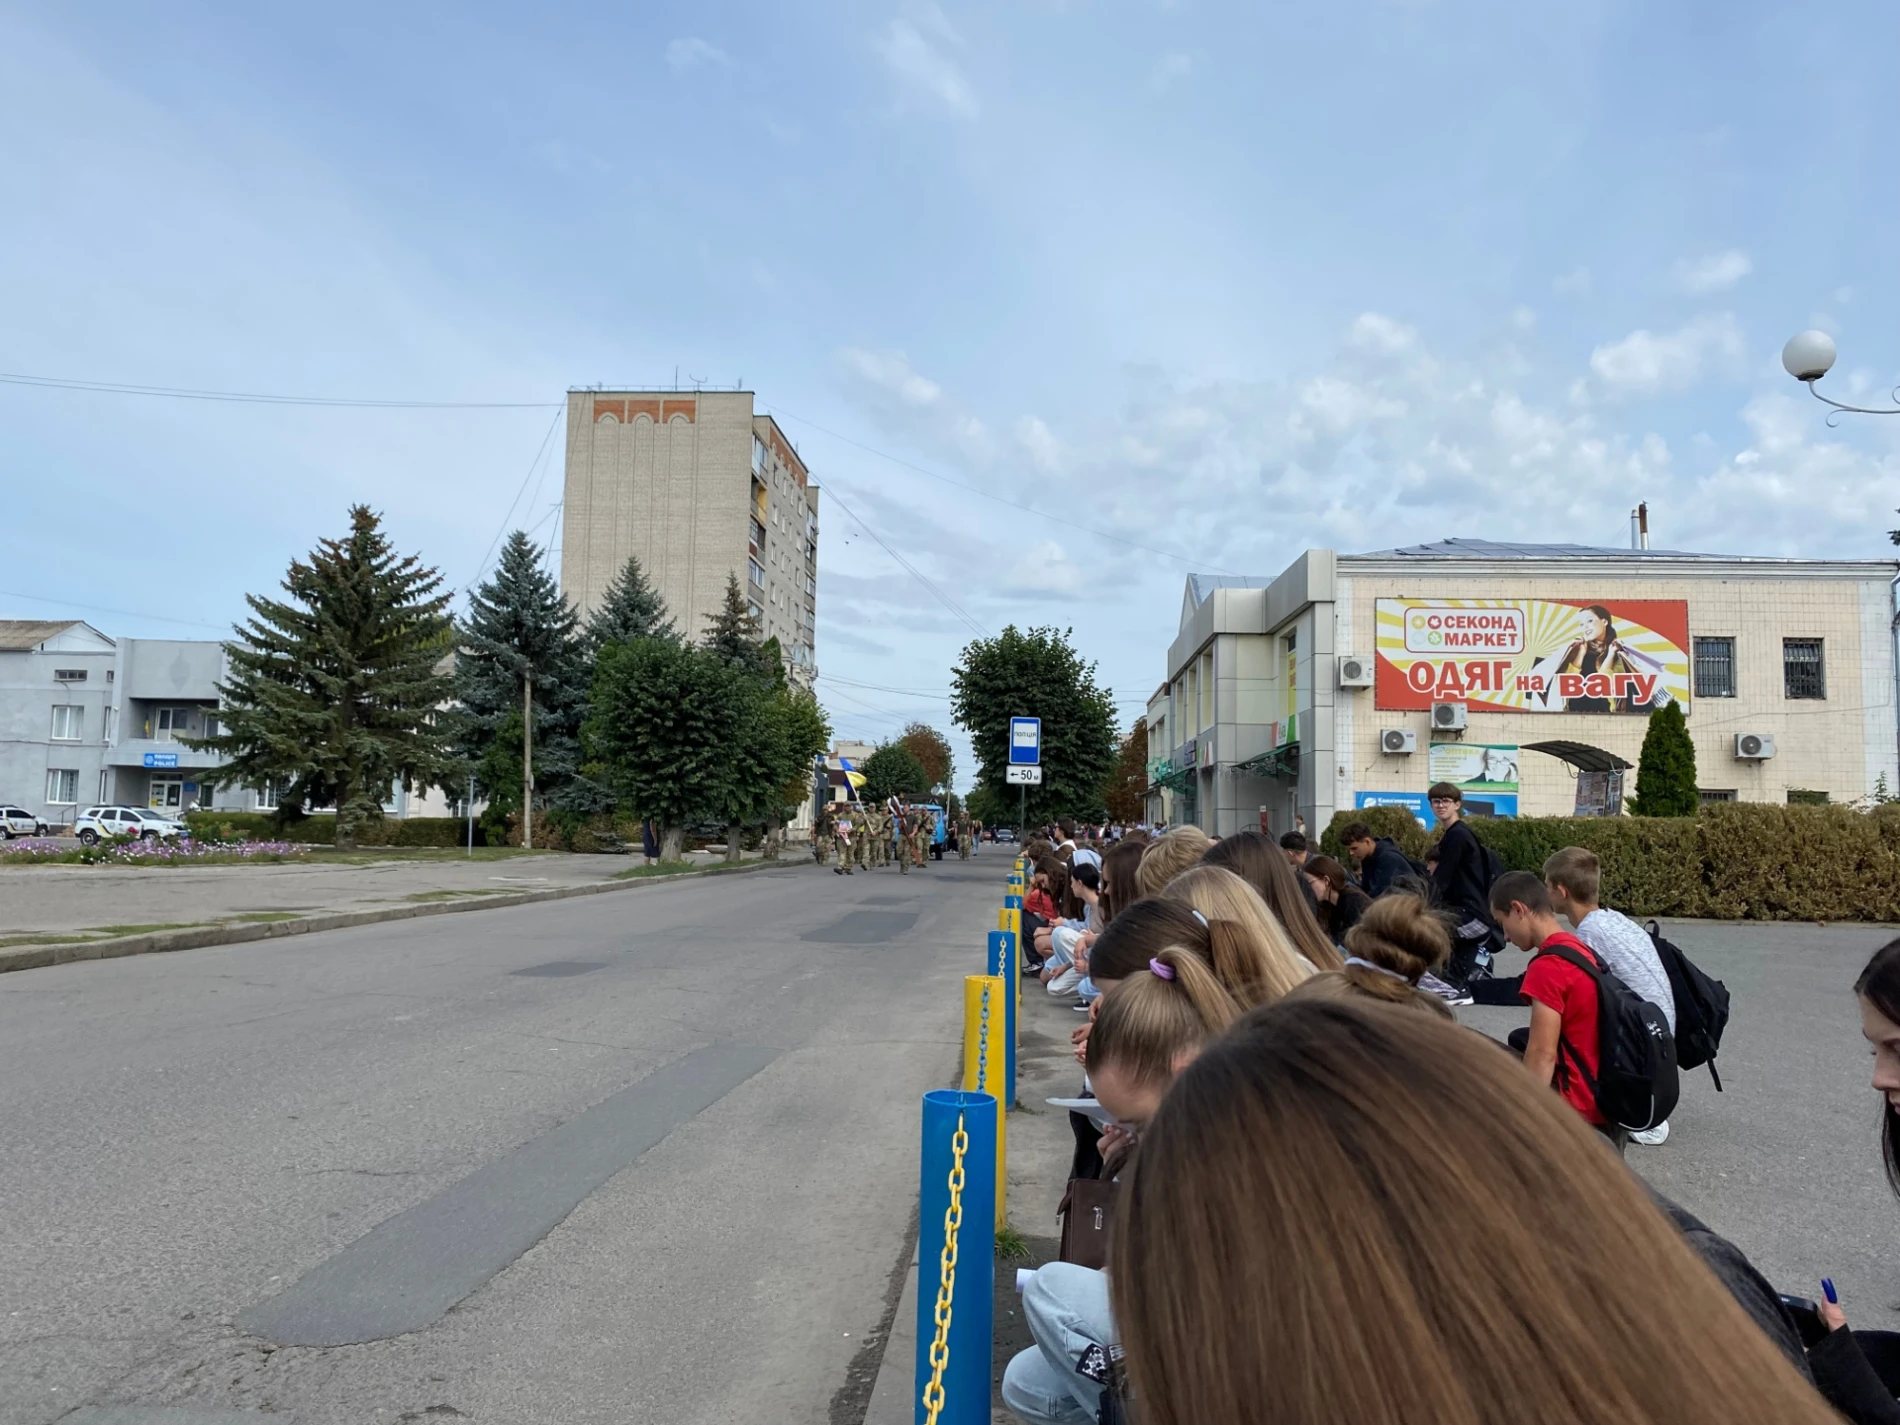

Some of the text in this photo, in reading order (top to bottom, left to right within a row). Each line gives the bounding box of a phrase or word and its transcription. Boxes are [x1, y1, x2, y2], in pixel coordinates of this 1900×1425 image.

[1444, 615, 1517, 631] СЕКОНД
[1444, 633, 1518, 646] МАРКЕТ
[1408, 661, 1512, 697] ОДЯГ
[1516, 675, 1545, 691] на
[1559, 674, 1658, 703] вагу
[1020, 769, 1033, 780] 50
